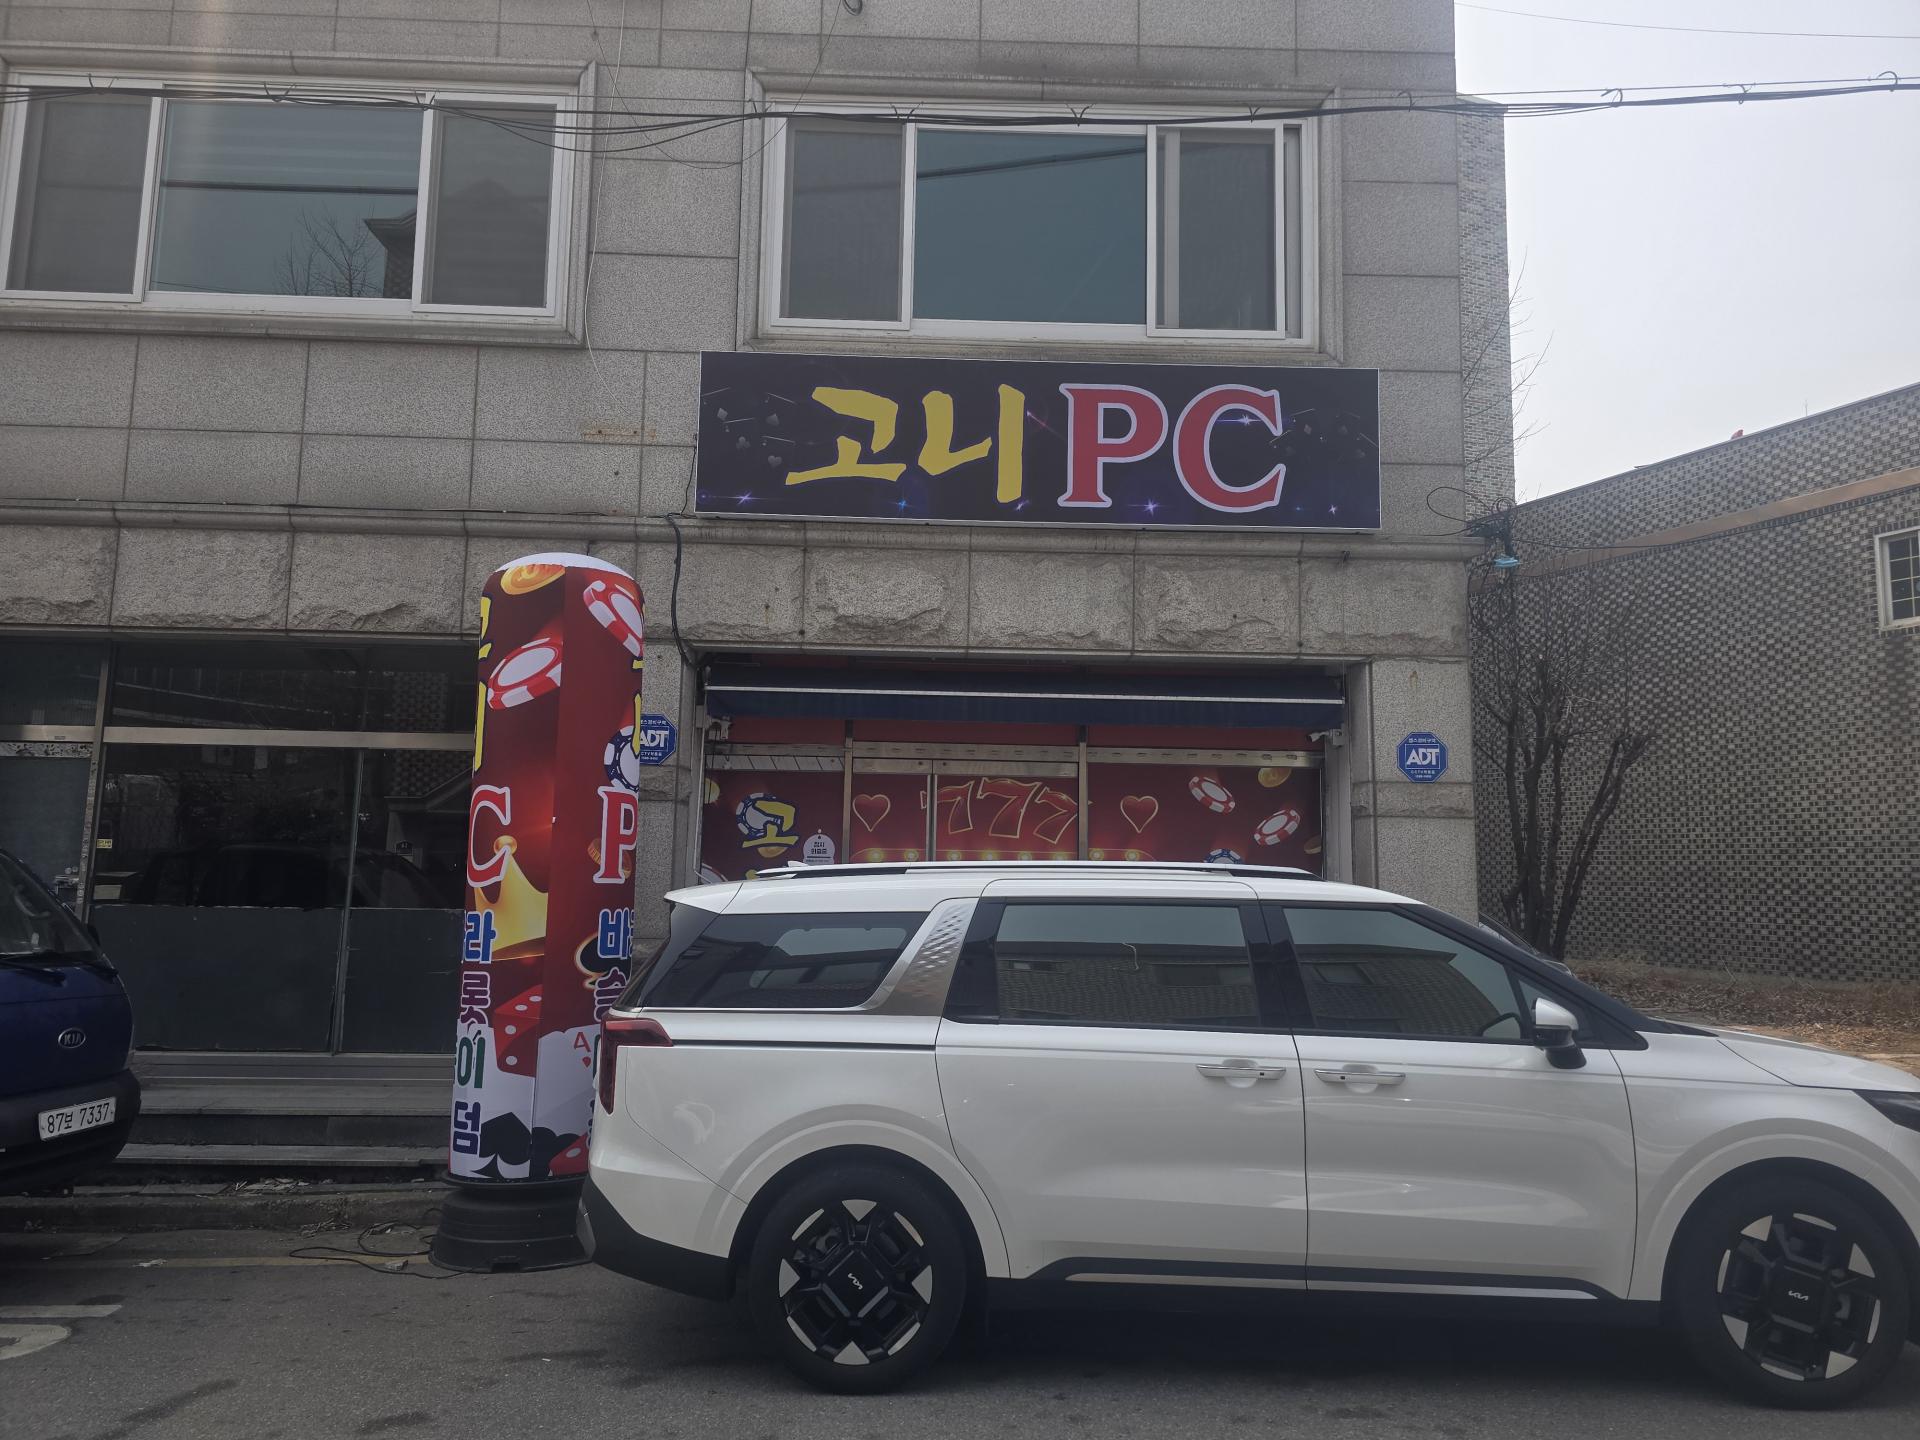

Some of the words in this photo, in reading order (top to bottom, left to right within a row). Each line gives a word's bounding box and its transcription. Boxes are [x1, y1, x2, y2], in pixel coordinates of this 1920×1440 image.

[785, 384, 1025, 504] 고니
[1058, 383, 1287, 511] PC
[640, 729, 669, 748] ADT
[1406, 747, 1440, 766] ADT
[47, 1111, 74, 1134] 87보
[80, 1102, 110, 1127] 7337
